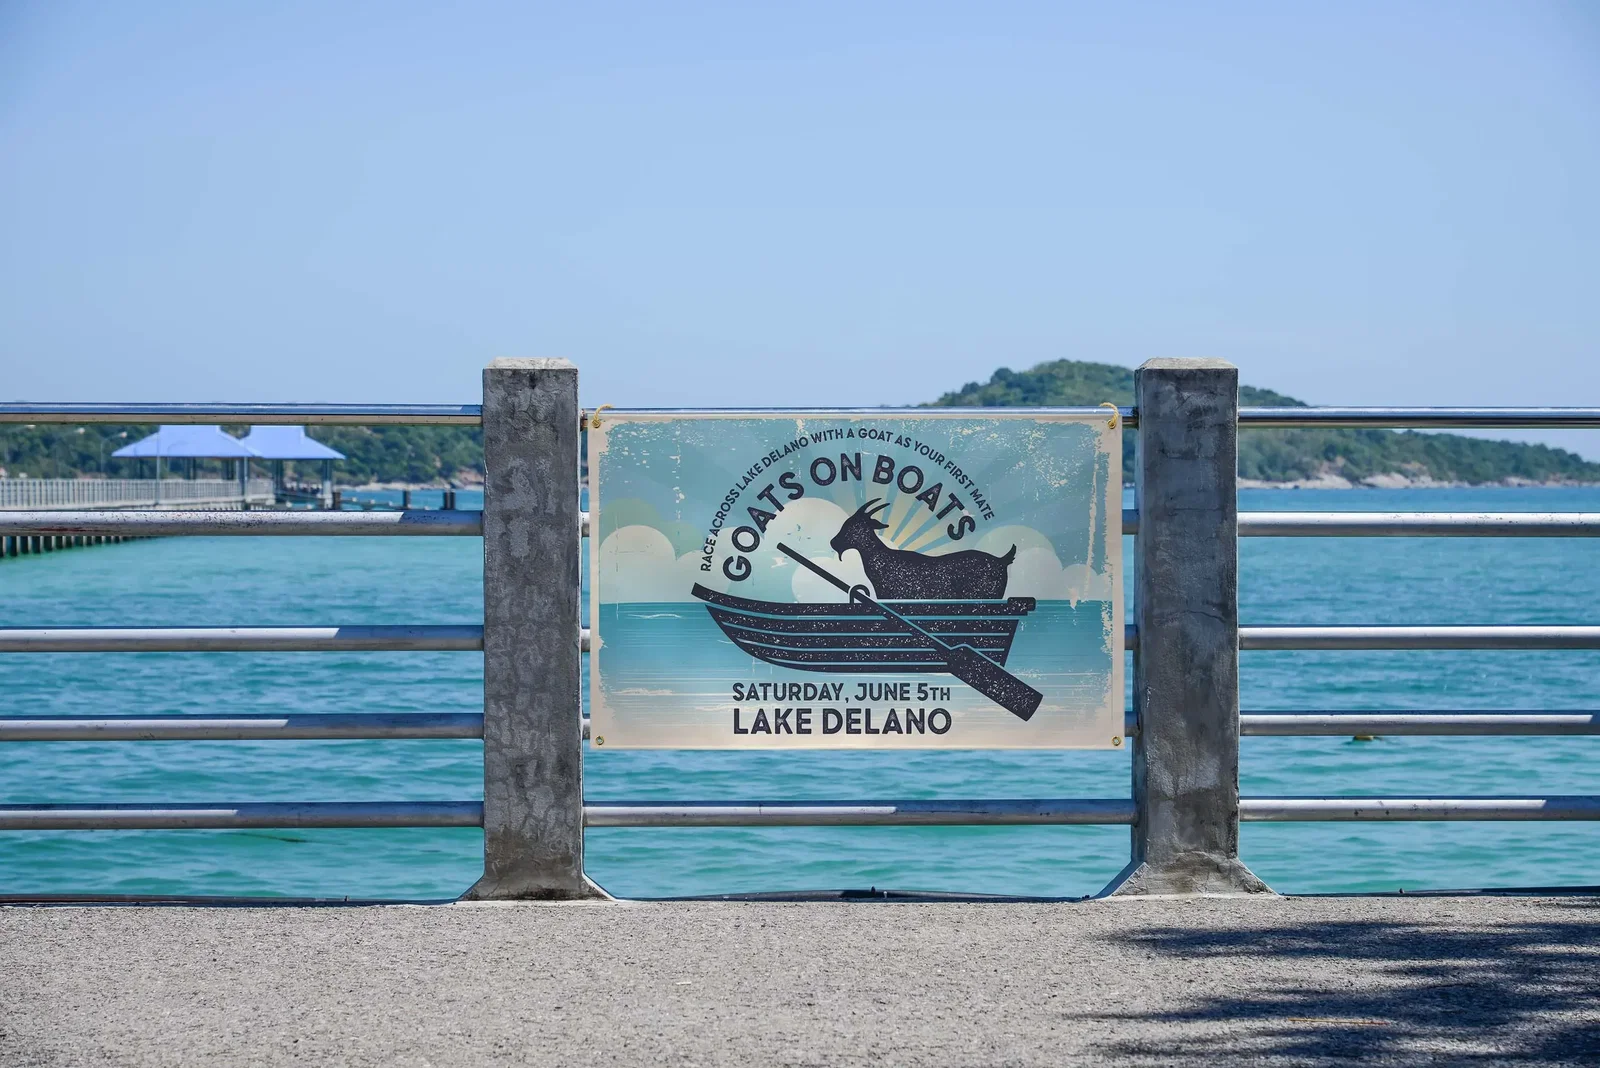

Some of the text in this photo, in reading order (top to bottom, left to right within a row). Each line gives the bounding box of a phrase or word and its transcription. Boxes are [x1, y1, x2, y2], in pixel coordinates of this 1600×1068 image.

[700, 427, 995, 572] RACE ACROSS LAKE DELANO WITH A GOAT AS YOUR FIRST MATE
[722, 452, 976, 582] GOATS ON BOATS
[732, 682, 951, 703] SATURDAY, JUNE 5TH
[733, 708, 952, 735] LAKE DELANO
